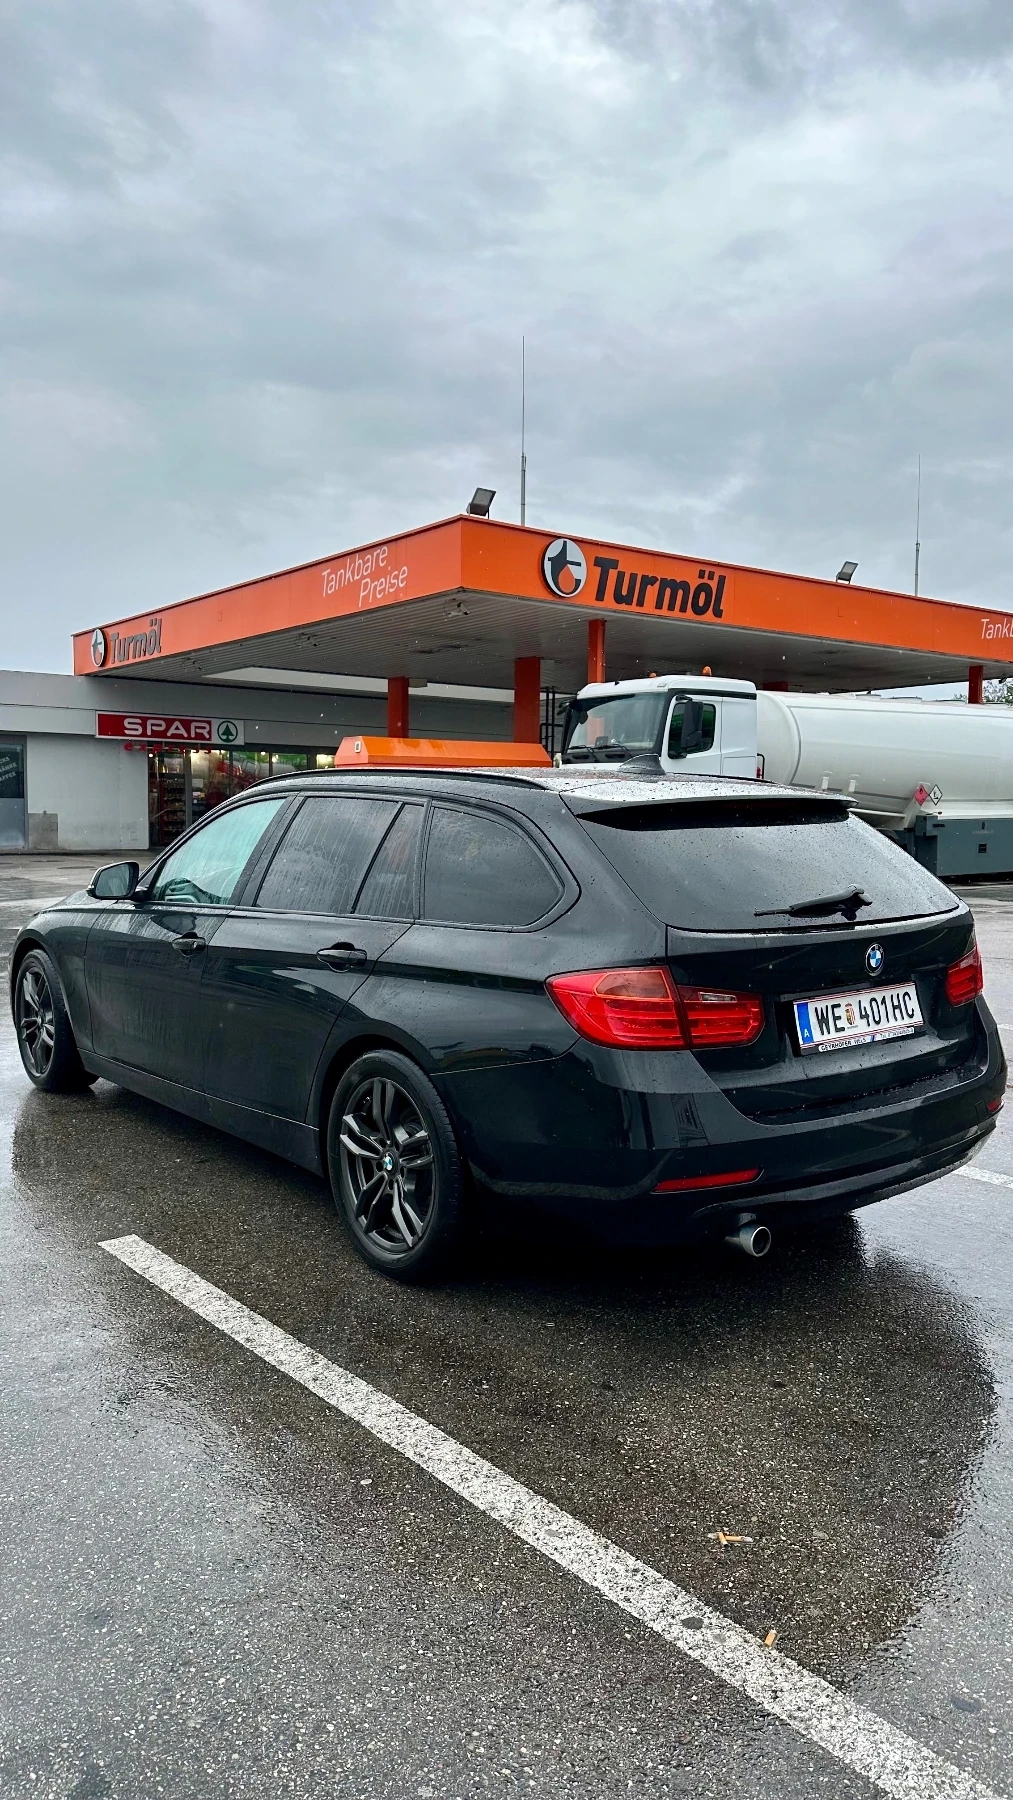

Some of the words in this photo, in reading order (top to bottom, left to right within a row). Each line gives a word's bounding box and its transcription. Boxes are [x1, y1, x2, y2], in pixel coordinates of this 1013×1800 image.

[321, 546, 388, 597] Tankbare
[358, 565, 408, 608] Preise
[593, 556, 726, 619] Turmöl
[111, 618, 163, 665] Turmöl
[123, 717, 210, 739] SPAR
[123, 742, 212, 754] express
[804, 1029, 810, 1038] A
[814, 1003, 845, 1036] WE
[858, 991, 915, 1027] 401HC
